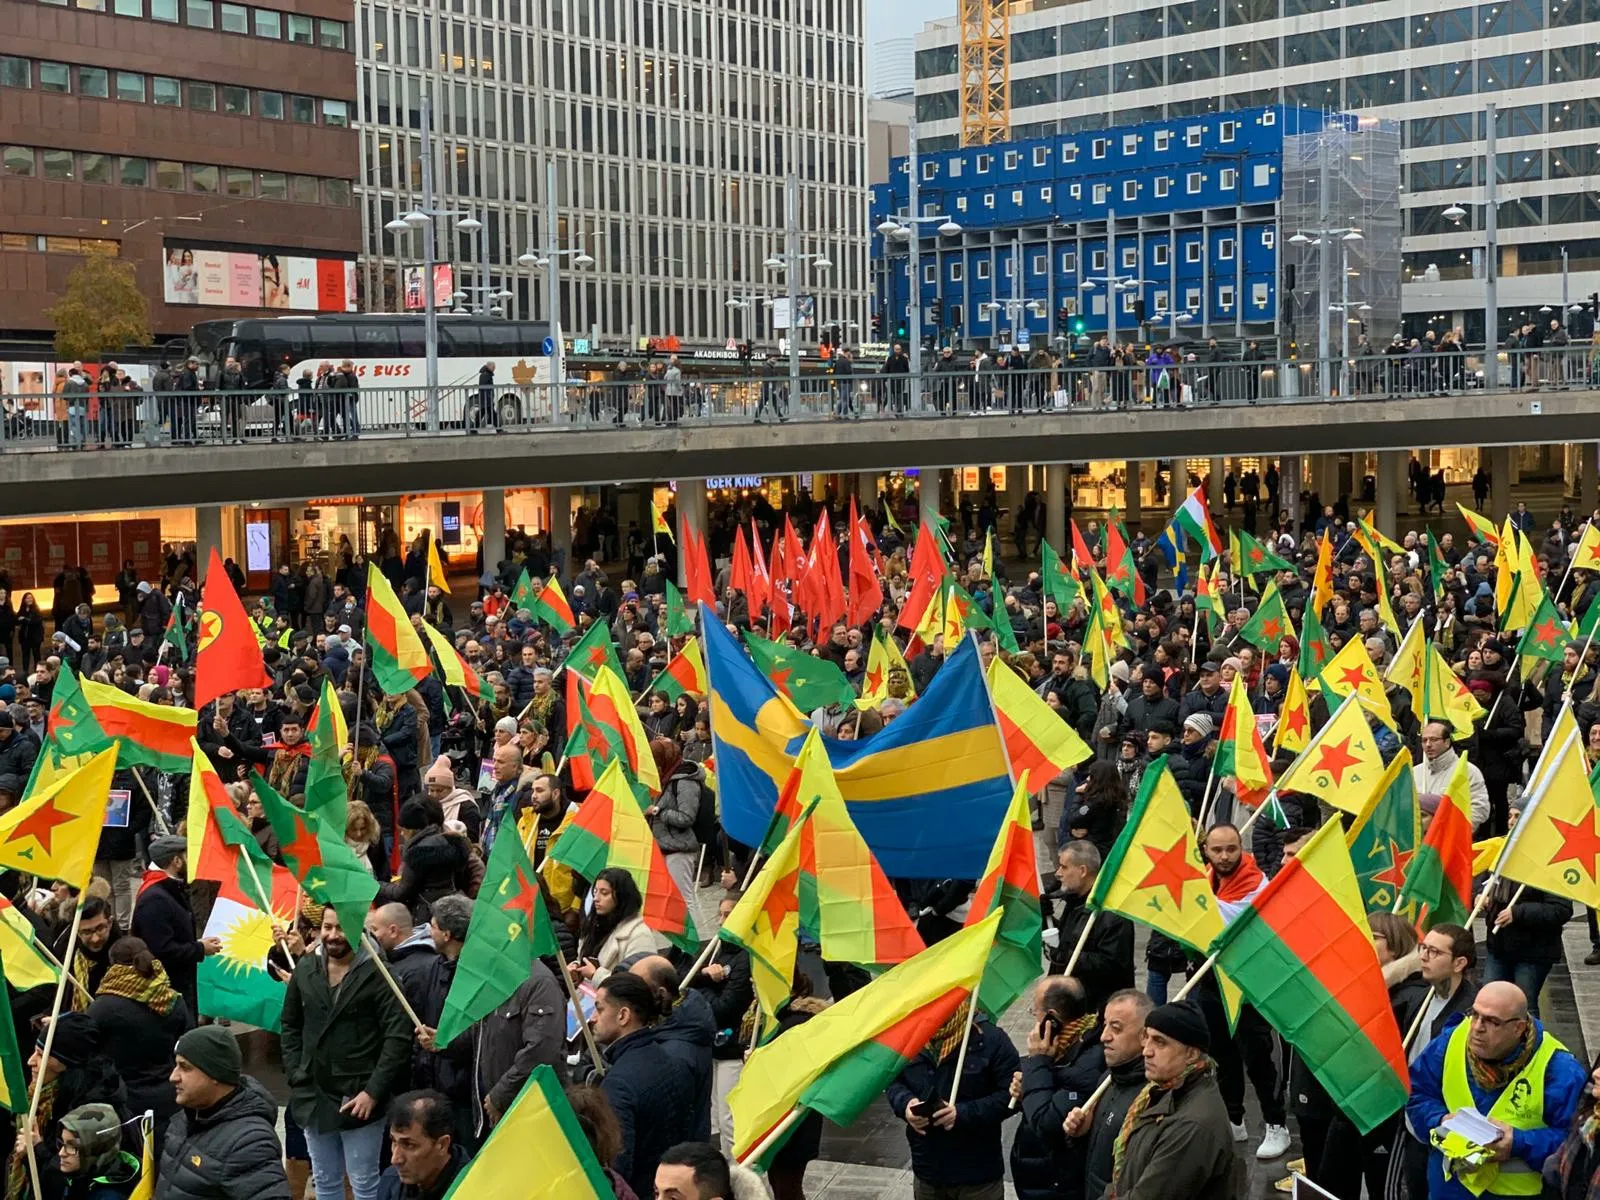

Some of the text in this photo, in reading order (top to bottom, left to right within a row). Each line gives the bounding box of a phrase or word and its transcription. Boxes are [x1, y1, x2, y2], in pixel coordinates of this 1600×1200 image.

[374, 364, 410, 377] BUSS
[706, 476, 762, 489] GER KING
